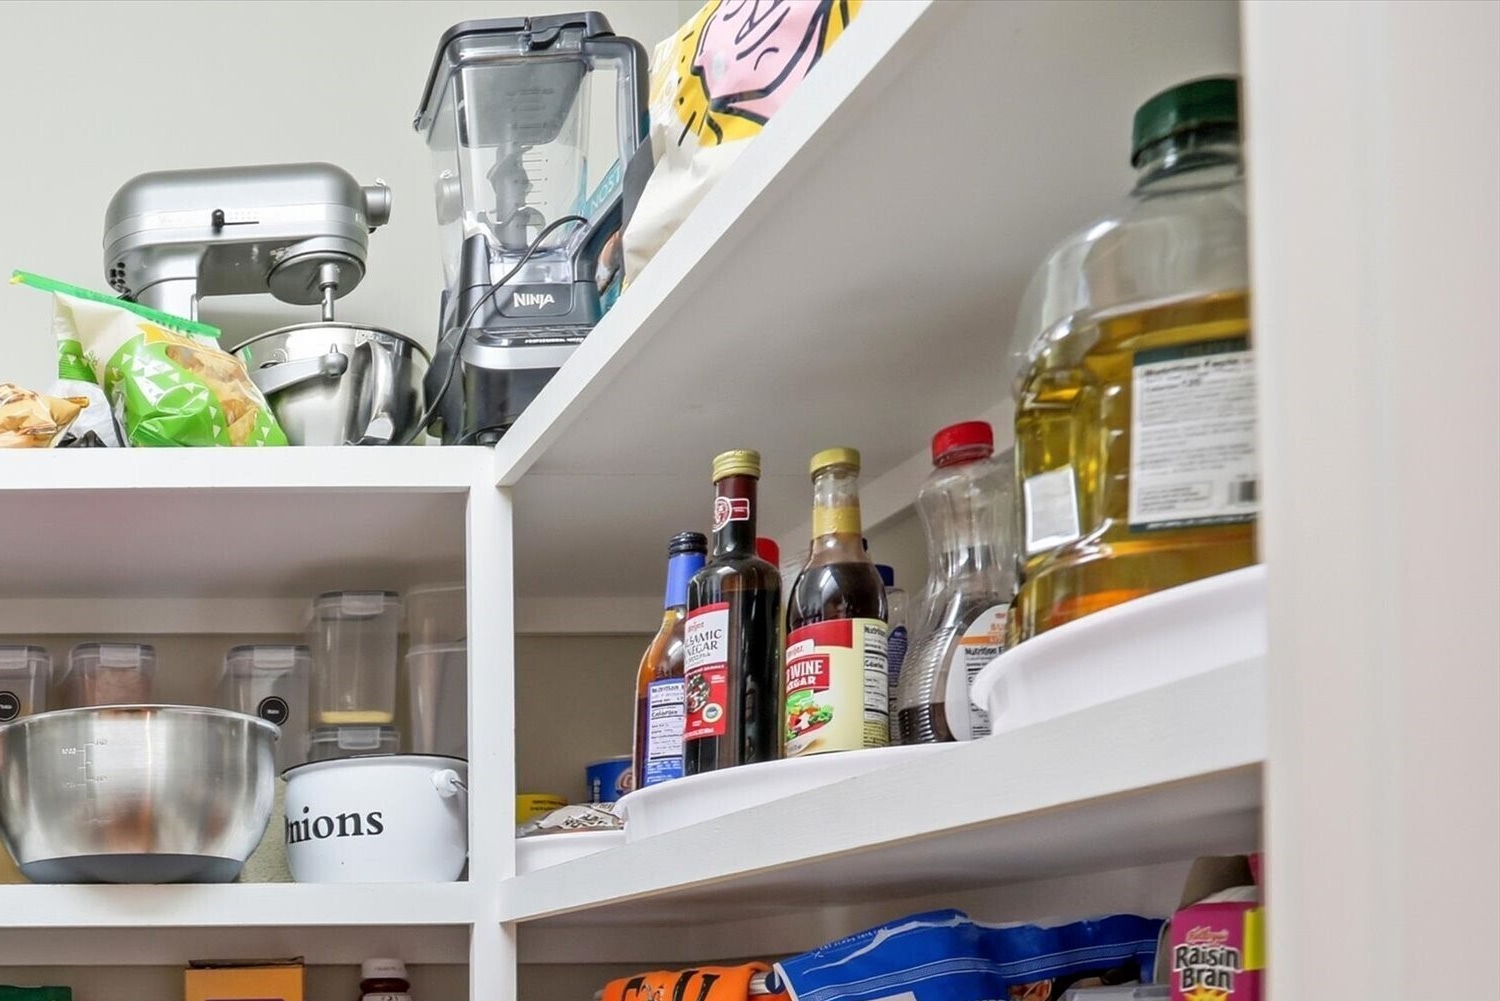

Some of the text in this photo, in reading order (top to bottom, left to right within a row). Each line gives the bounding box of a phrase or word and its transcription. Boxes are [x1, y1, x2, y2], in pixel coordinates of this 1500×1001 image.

[513, 292, 555, 309] NINJA
[790, 660, 824, 677] WINE
[284, 806, 385, 844] nions
[1176, 945, 1240, 970] Raisin
[1181, 967, 1233, 991] Bran
